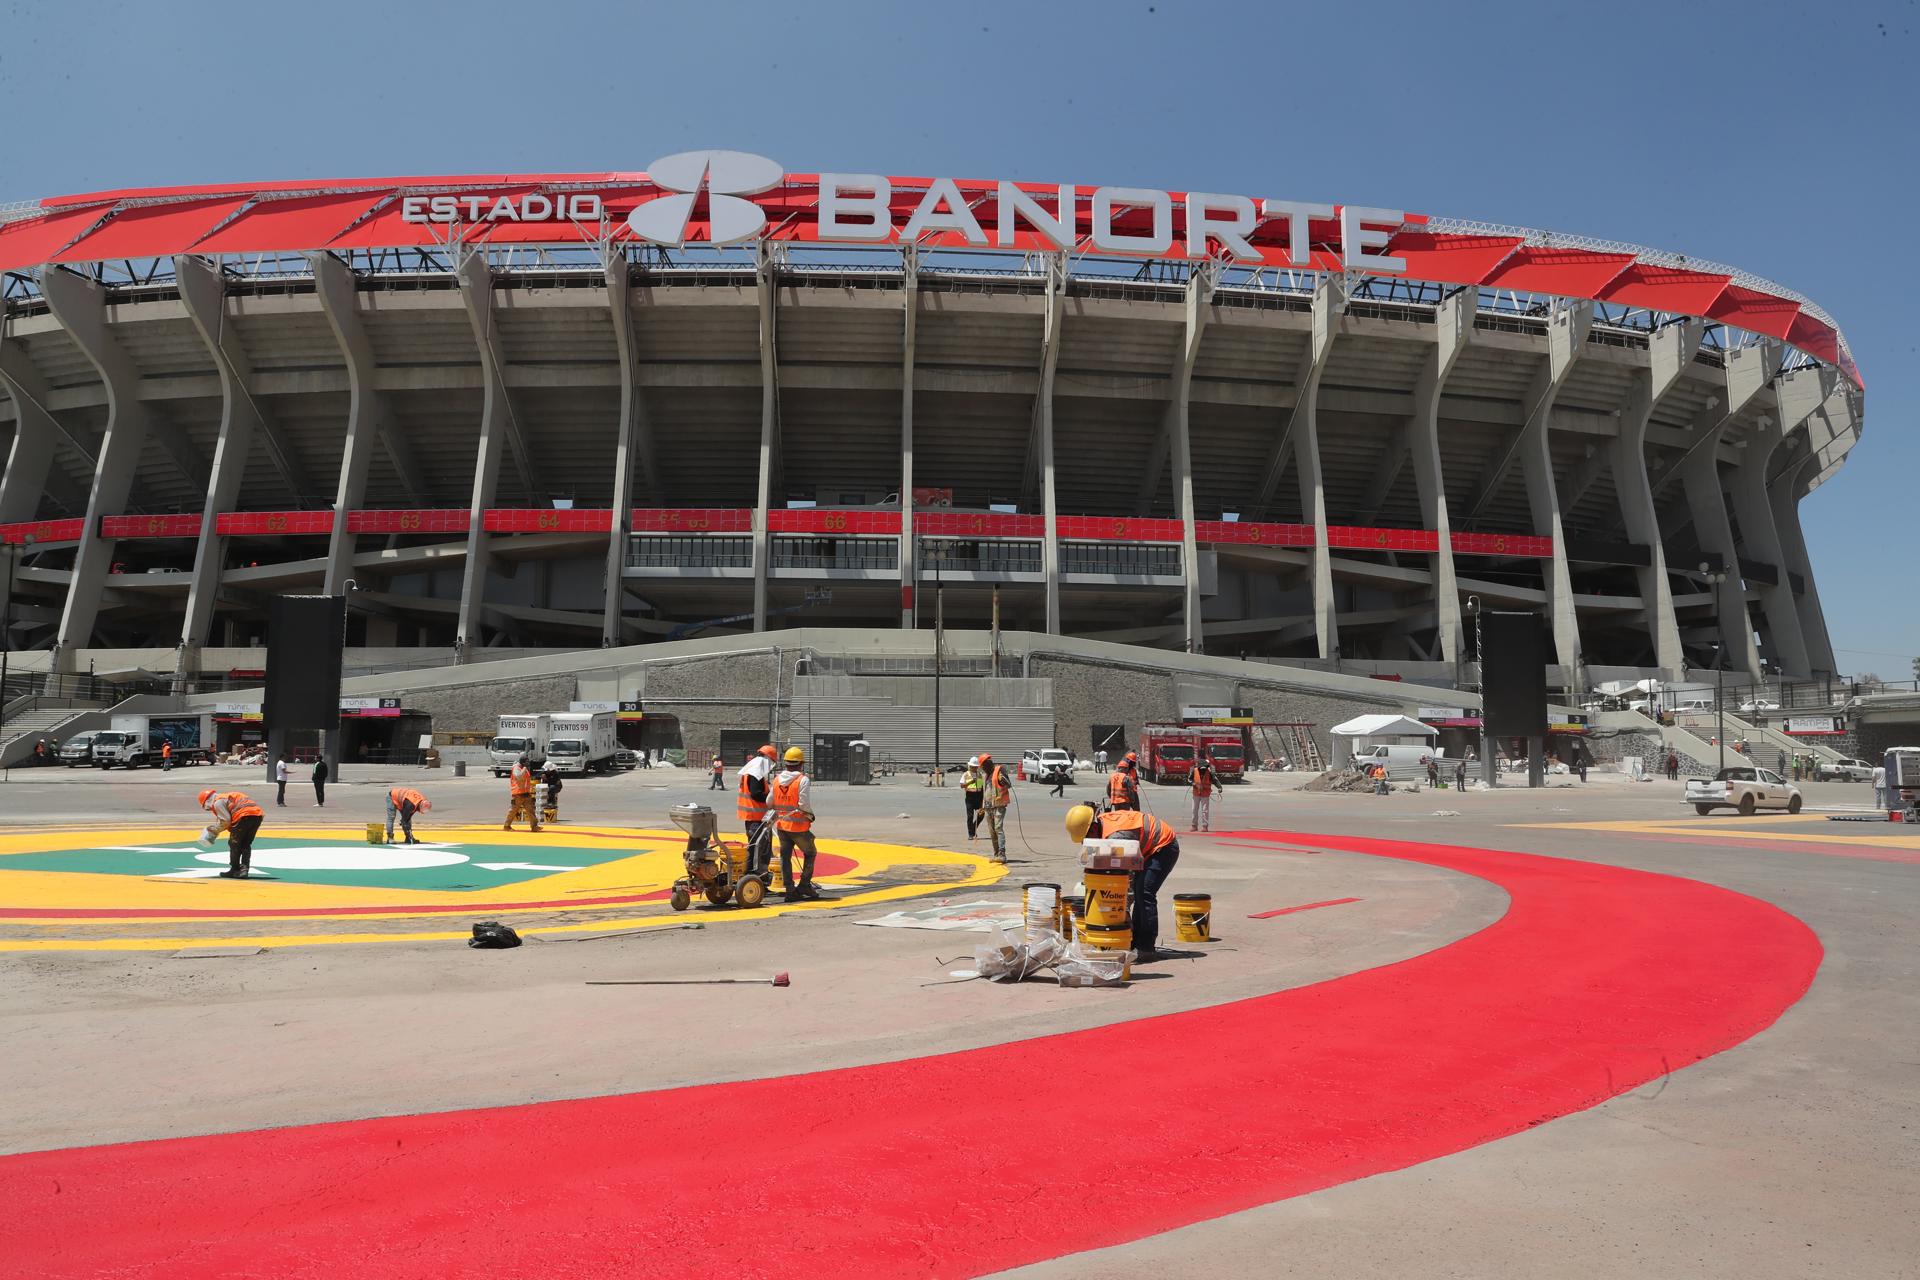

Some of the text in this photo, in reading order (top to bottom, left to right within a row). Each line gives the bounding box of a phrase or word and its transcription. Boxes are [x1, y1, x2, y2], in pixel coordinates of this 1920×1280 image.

[402, 172, 1407, 272] ESTADIO BANORTE
[268, 516, 287, 530] 62
[400, 514, 420, 528] 63
[539, 513, 560, 528] 64
[825, 515, 846, 529] 66
[975, 518, 983, 533] 1
[1114, 522, 1125, 536] 2
[1250, 527, 1261, 541] 3
[1379, 532, 1387, 545] 4
[1496, 538, 1505, 552] 5
[625, 703, 636, 711] 30
[1836, 718, 1842, 730] 1
